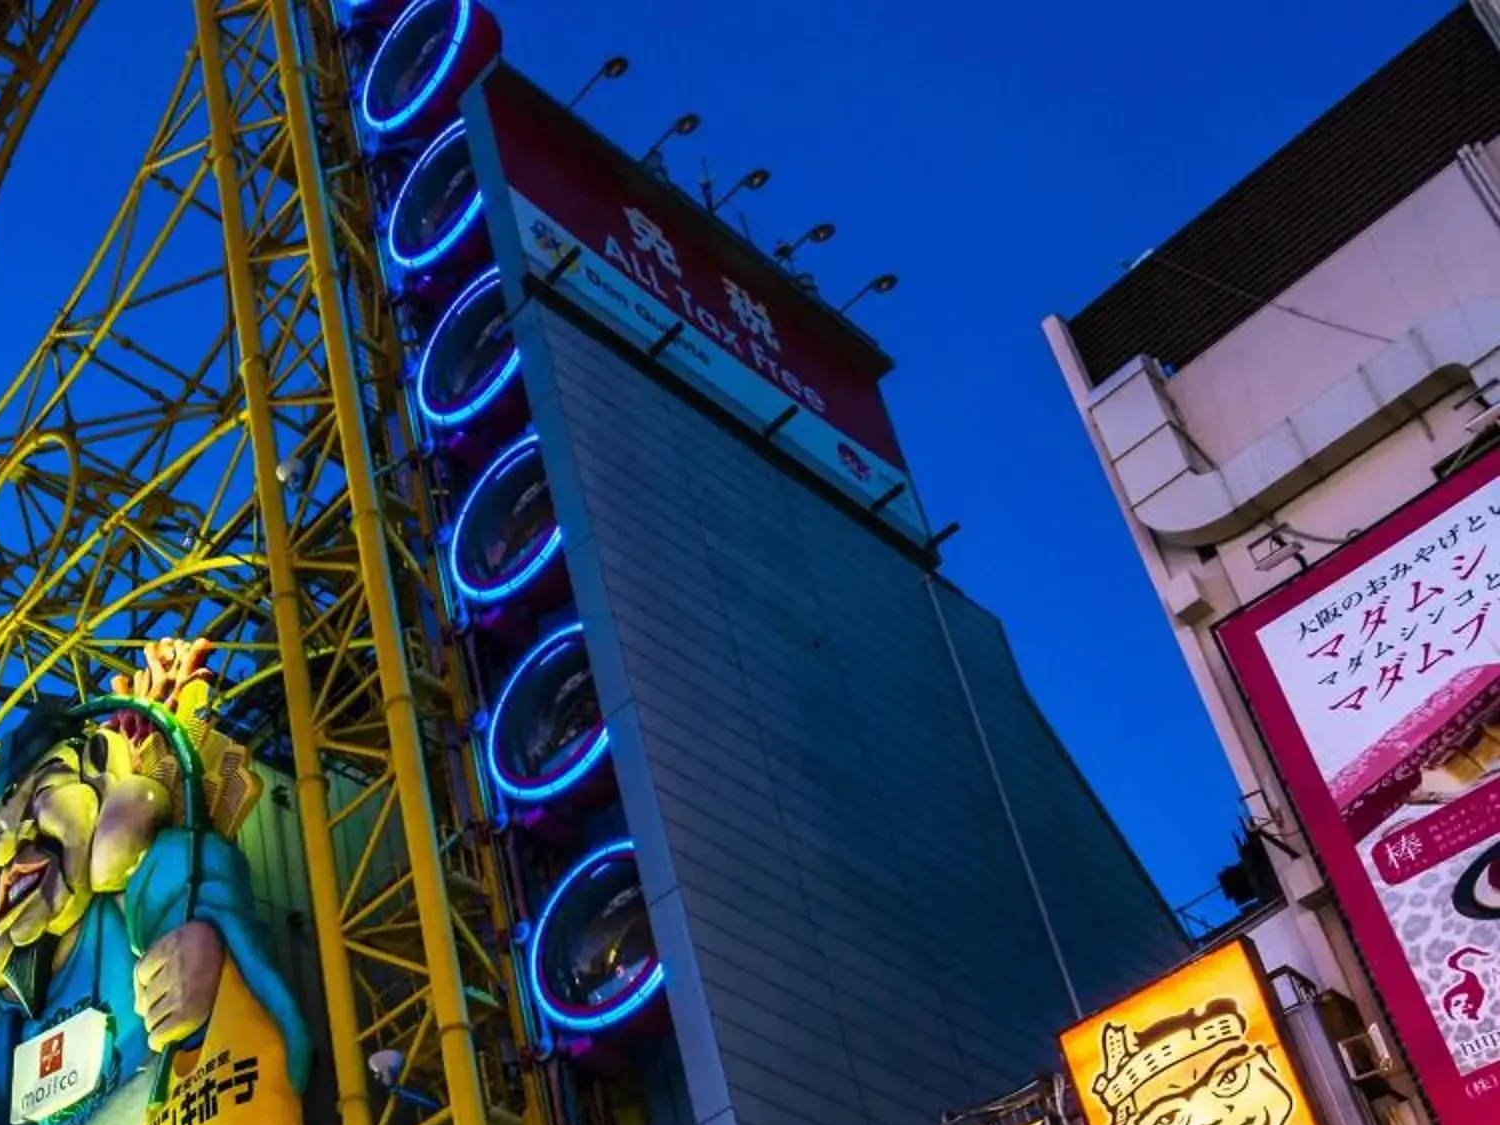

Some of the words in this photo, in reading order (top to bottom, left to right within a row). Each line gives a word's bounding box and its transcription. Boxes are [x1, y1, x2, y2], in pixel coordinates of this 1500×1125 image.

[605, 235, 669, 300] ALL
[675, 285, 743, 354] Tax
[750, 340, 827, 413] Free
